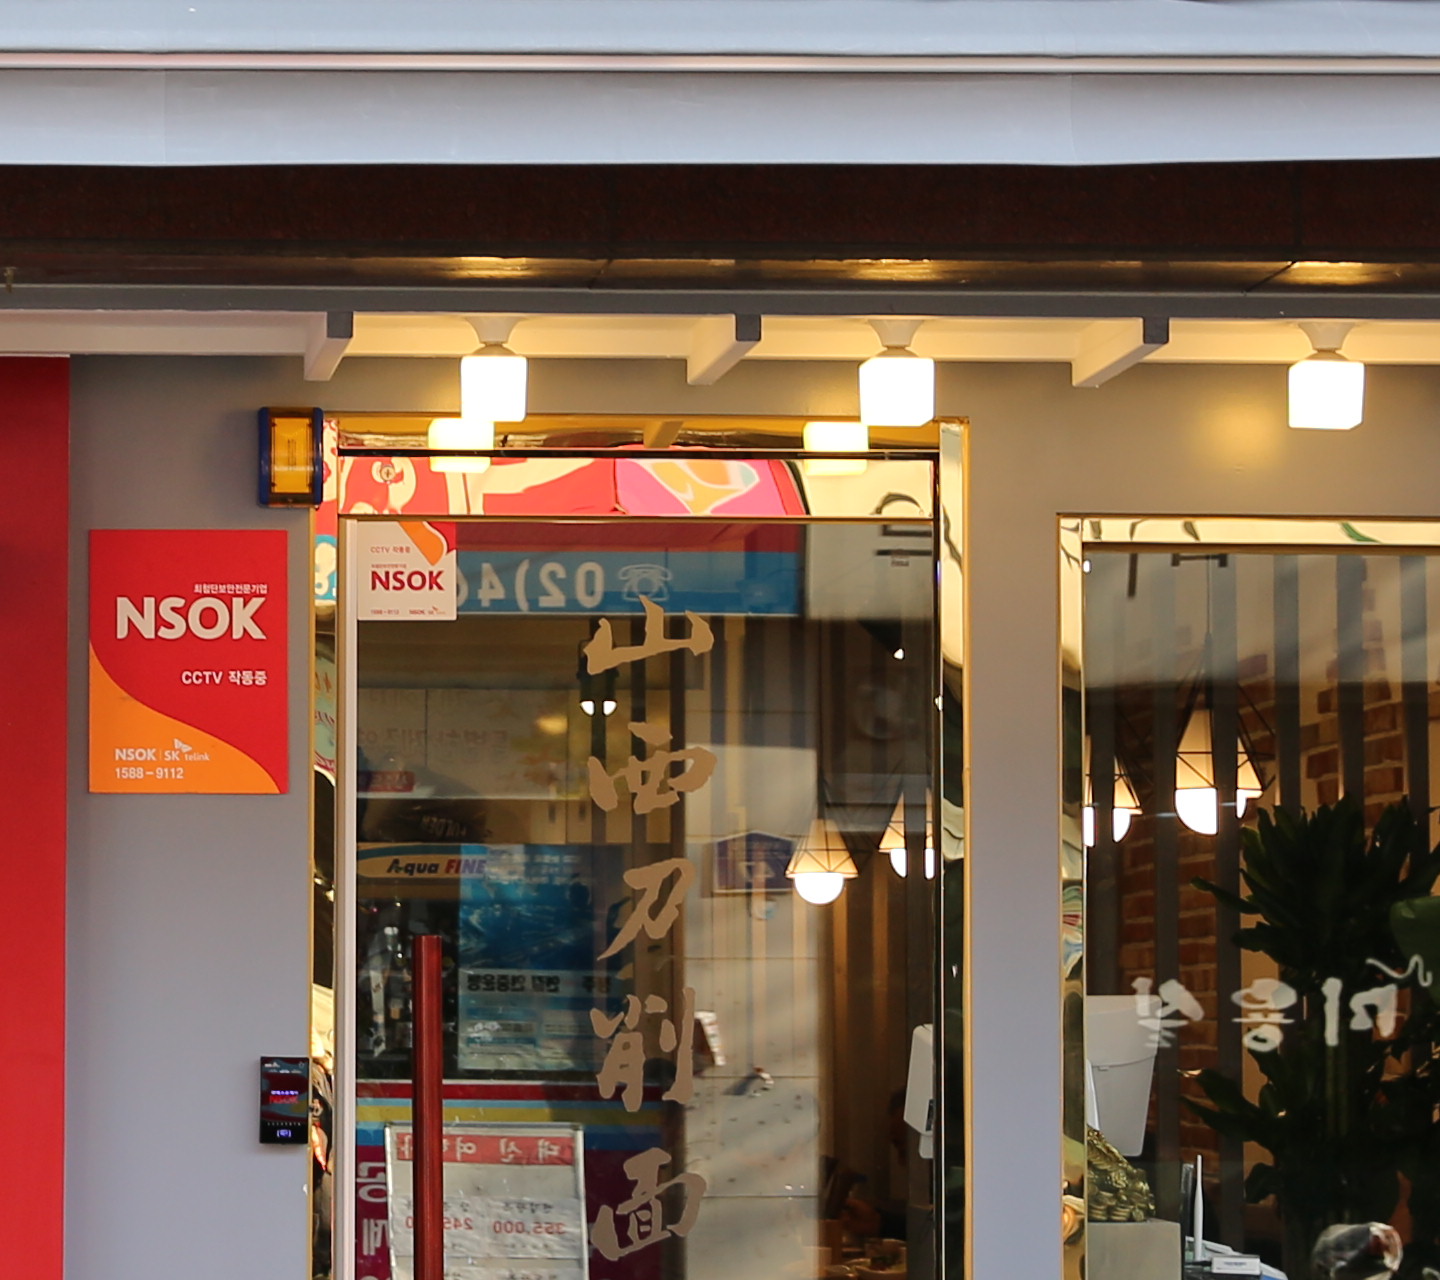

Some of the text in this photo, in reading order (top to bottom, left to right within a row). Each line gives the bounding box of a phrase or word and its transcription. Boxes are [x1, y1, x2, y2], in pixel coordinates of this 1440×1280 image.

[371, 570, 445, 591] NSOK
[116, 596, 268, 640] NSOK
[181, 670, 268, 686] CCTV 작동중
[114, 748, 157, 762] NSOK
[164, 748, 181, 762] SK
[444, 858, 488, 876] FINE
[582, 593, 720, 1263] 山西刀削面
